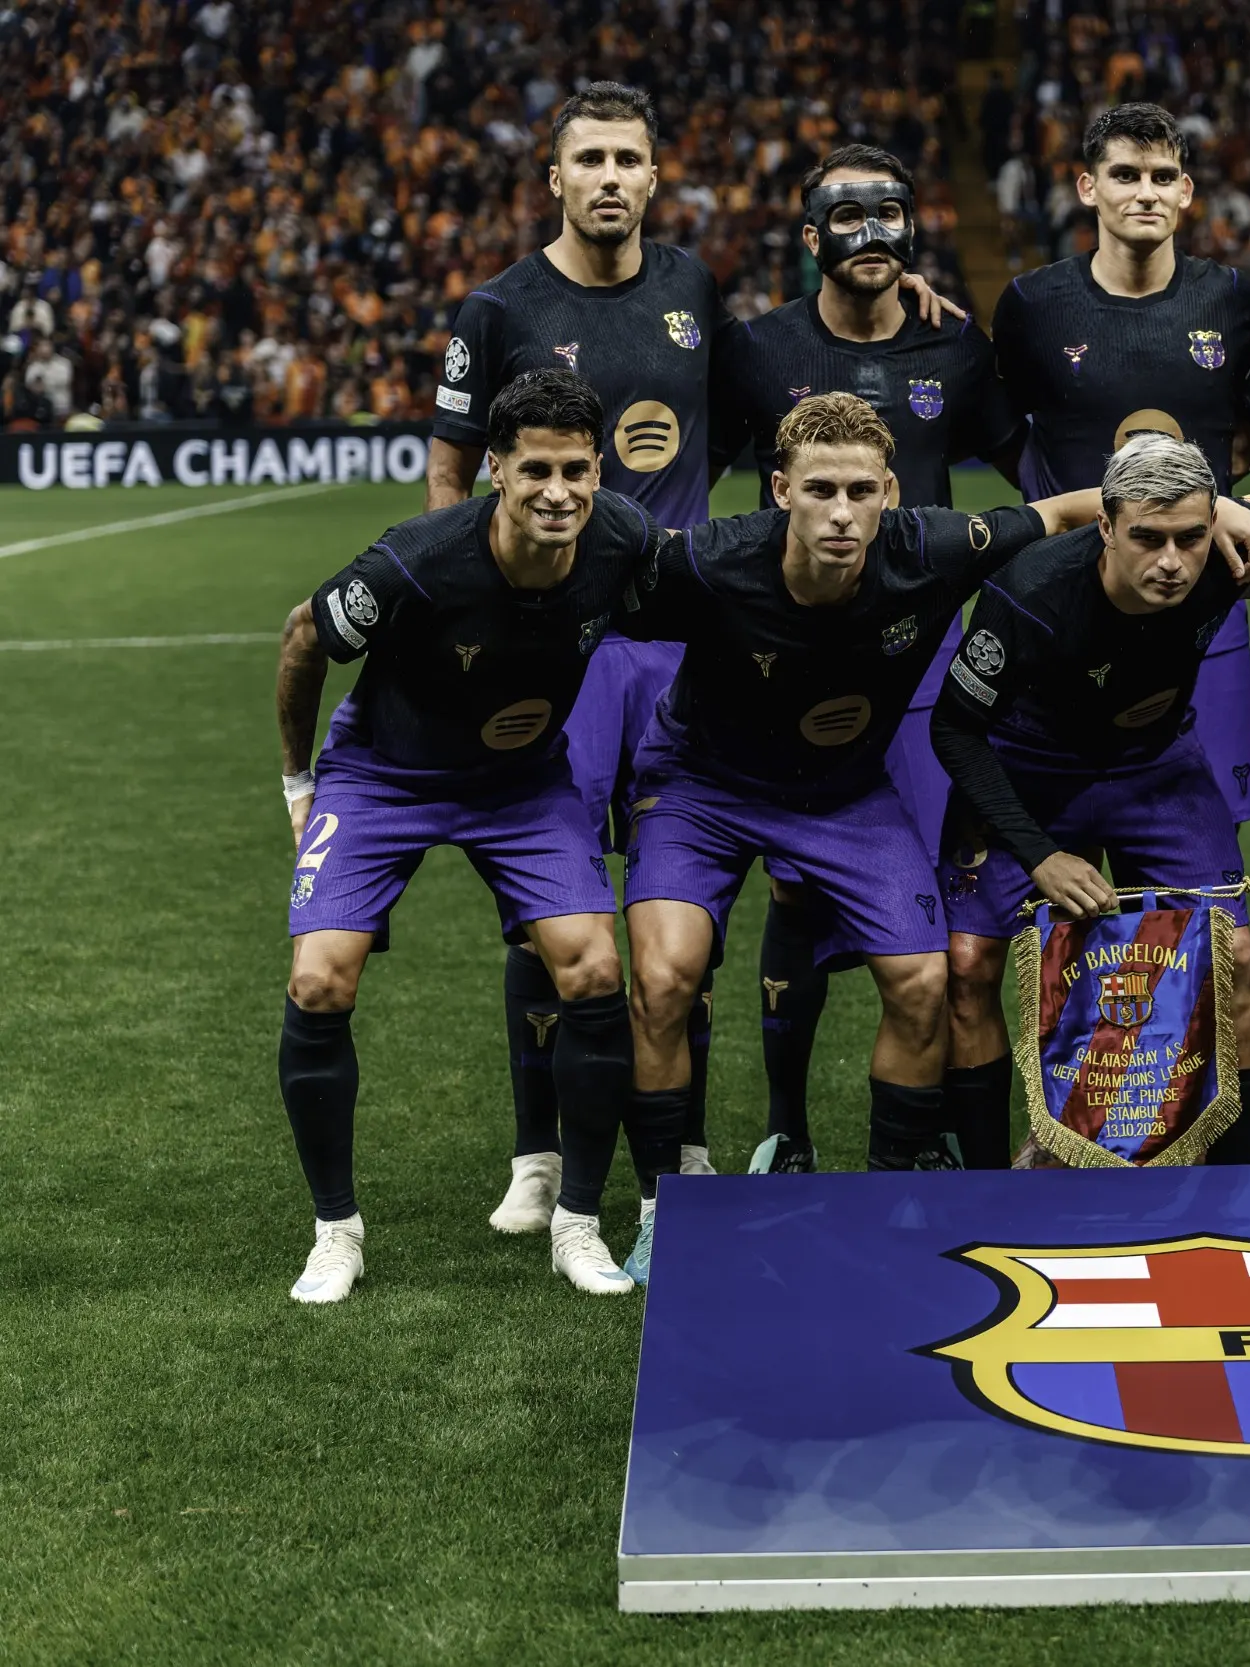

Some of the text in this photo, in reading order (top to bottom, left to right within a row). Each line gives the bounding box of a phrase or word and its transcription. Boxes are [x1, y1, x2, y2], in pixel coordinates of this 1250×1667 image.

[18, 434, 431, 490] UEFA CHAMPIO
[353, 597, 366, 611] 5
[978, 645, 991, 661] 5
[296, 812, 339, 872] 2
[1061, 943, 1189, 987] FC BARCELONA
[1122, 1035, 1140, 1051] AL
[1076, 1041, 1188, 1068] GALATASARAY A.S.
[1053, 1052, 1206, 1087] UEFA CHAMPIONS LEAGUE
[1086, 1087, 1180, 1107] LEAGUE PHASE
[1105, 1105, 1163, 1121] ISTAMBUL
[1105, 1121, 1166, 1138] 13.10.2026
